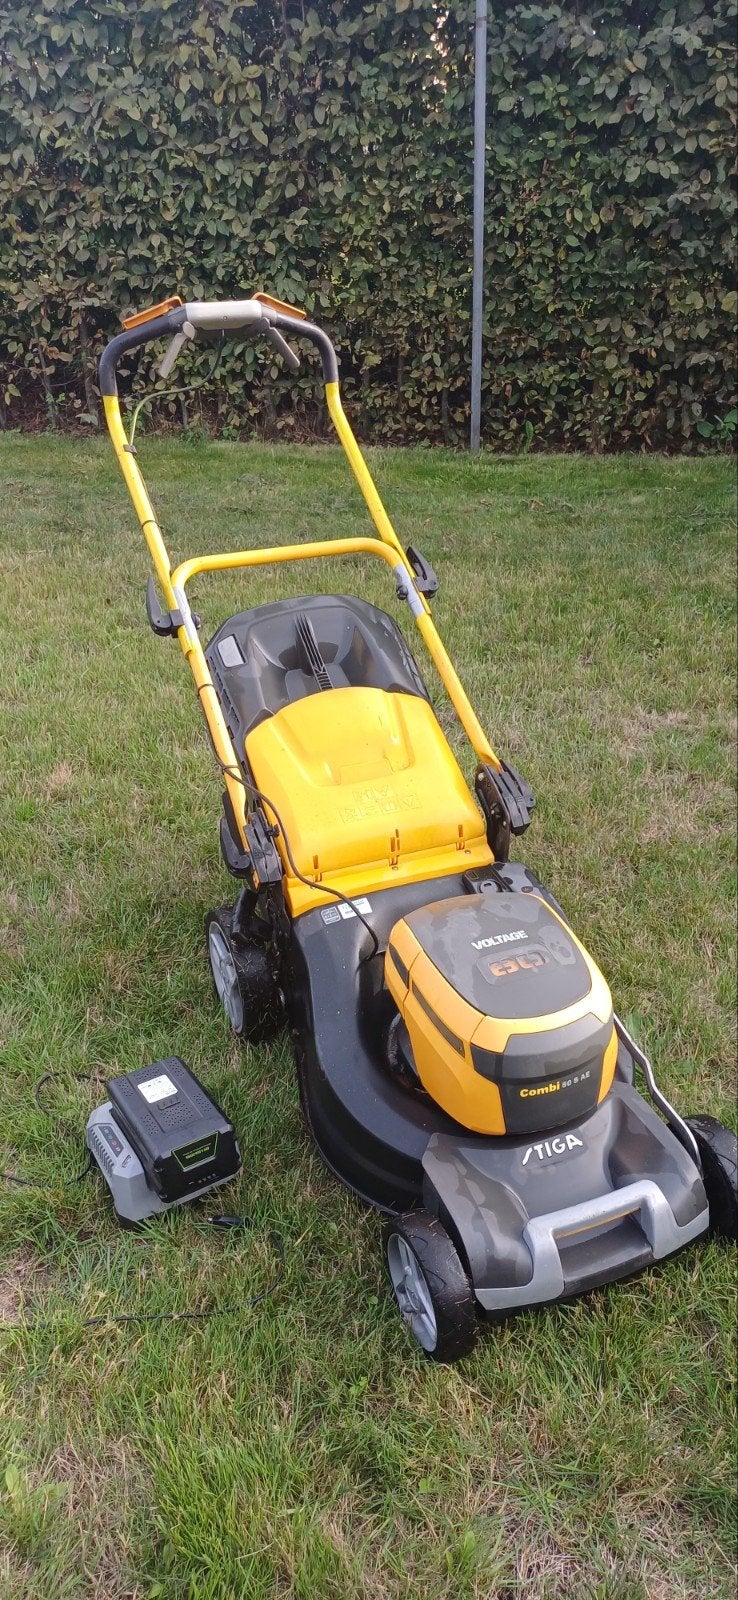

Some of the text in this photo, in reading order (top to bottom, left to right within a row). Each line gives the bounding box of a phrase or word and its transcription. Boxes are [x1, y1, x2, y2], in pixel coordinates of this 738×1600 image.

[471, 930, 528, 950] VOLTAGE
[519, 1081, 561, 1098] Combi
[580, 1070, 591, 1082] AE
[522, 1134, 583, 1166] STIGA
